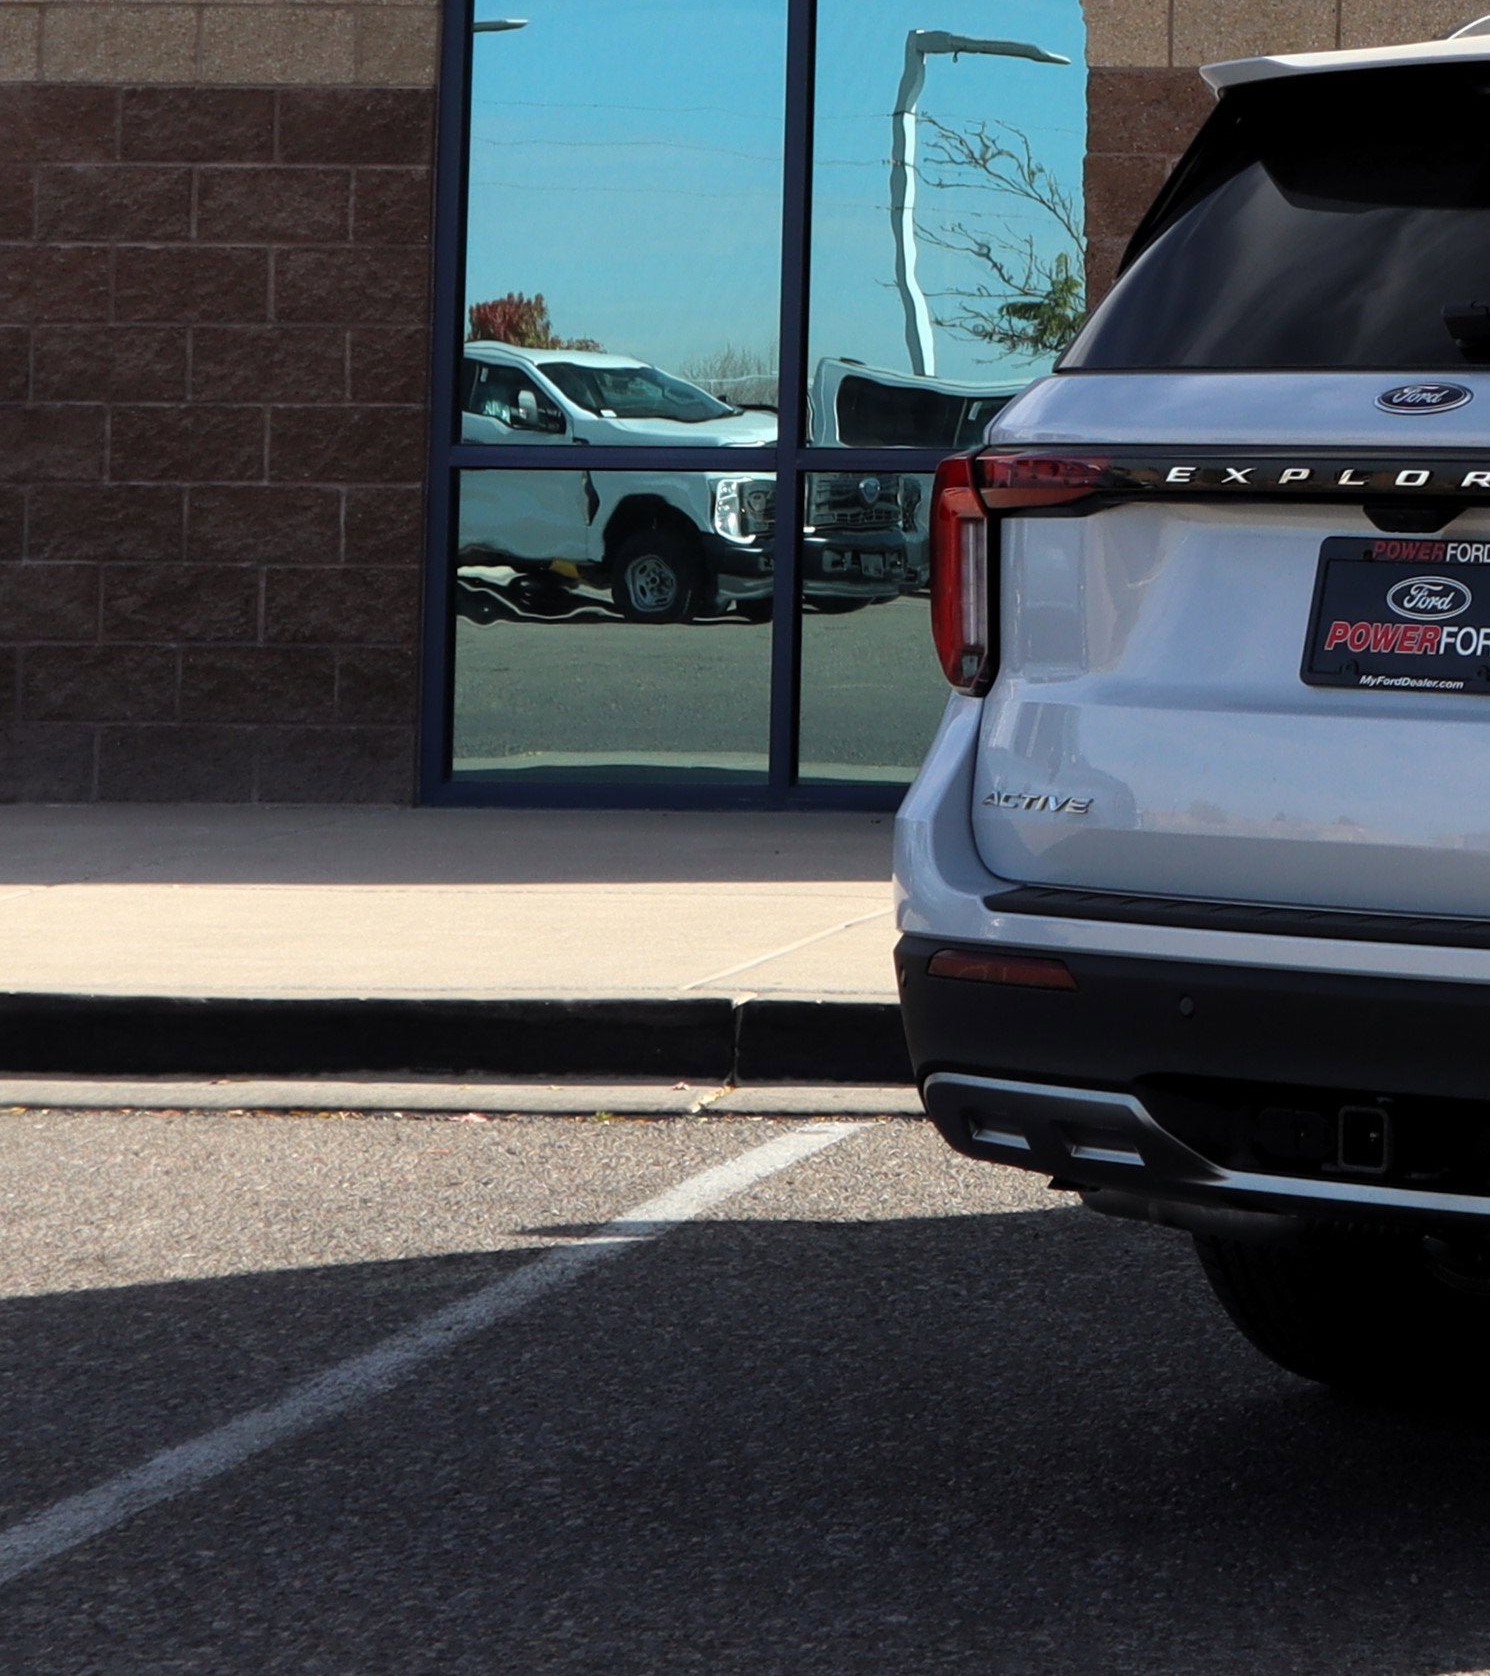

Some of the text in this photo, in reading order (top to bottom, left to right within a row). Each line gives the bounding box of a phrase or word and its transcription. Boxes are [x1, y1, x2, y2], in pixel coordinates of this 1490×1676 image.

[1391, 384, 1450, 404] Ford
[1403, 582, 1455, 611] Ford
[1358, 674, 1465, 690] MyFordDealer.com
[983, 791, 1095, 814] ACTIVE
